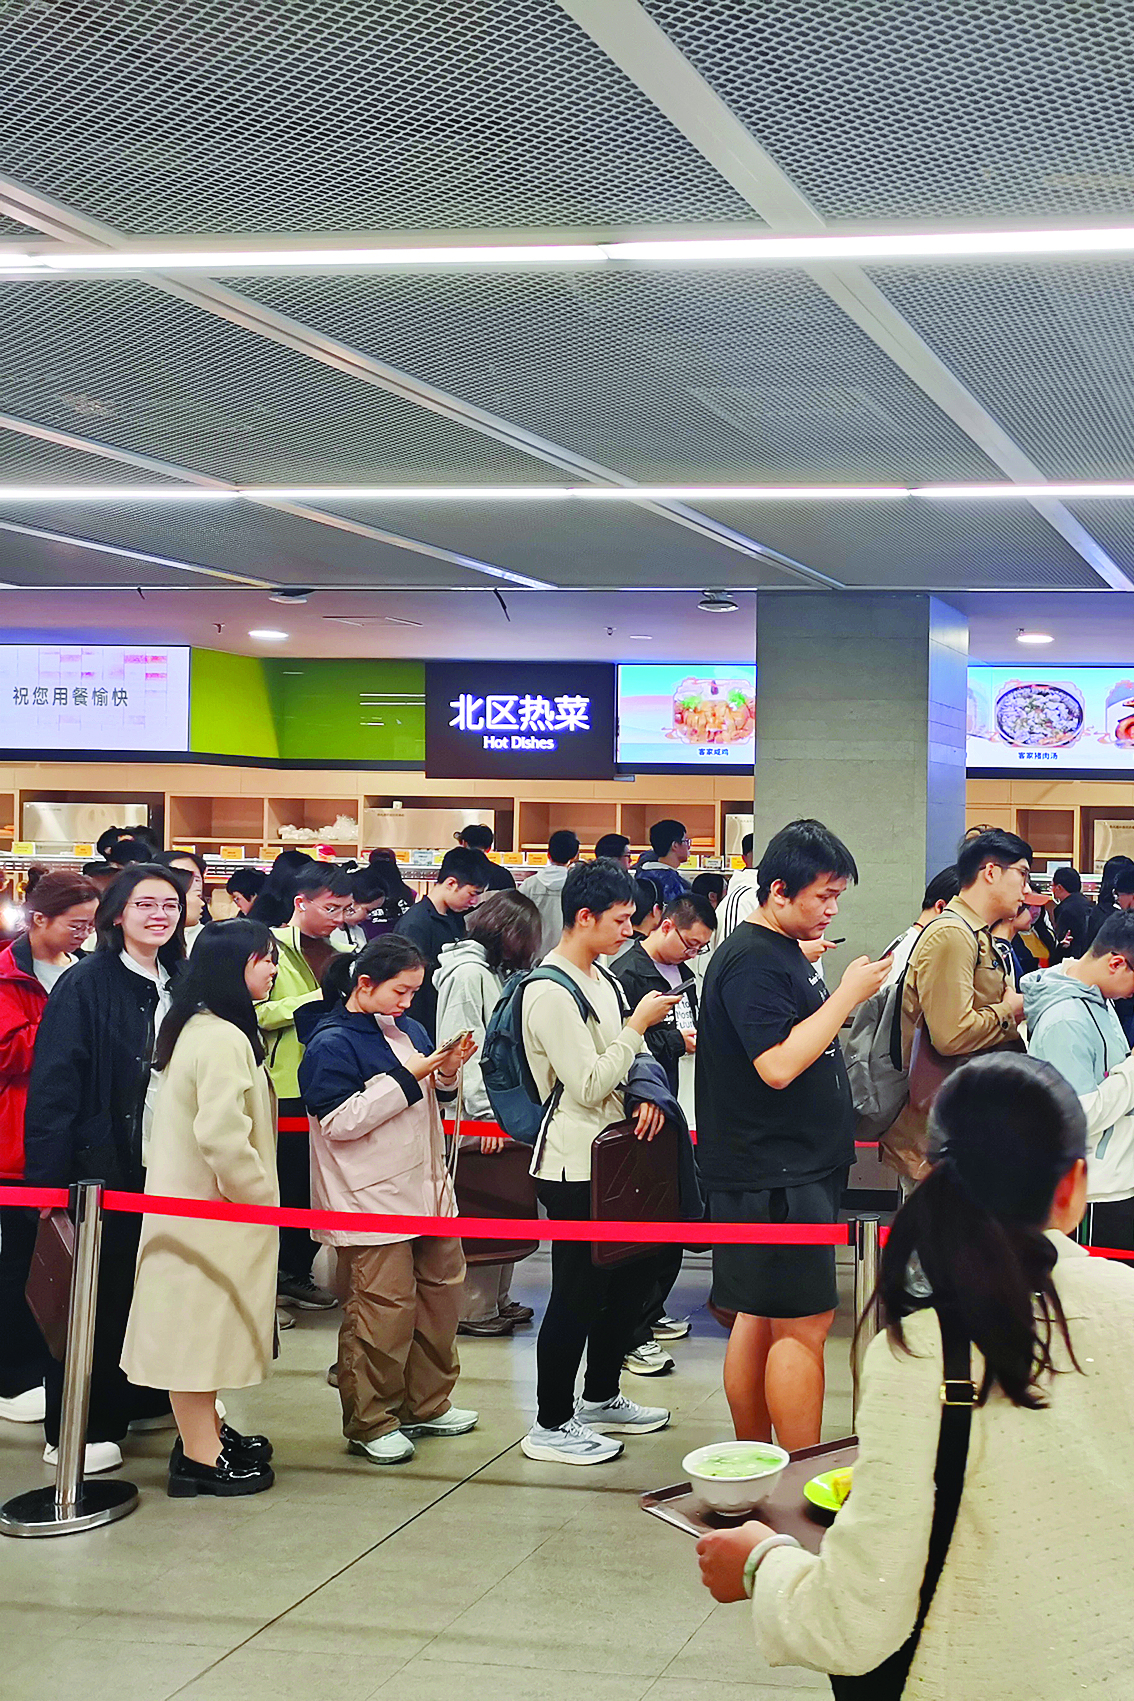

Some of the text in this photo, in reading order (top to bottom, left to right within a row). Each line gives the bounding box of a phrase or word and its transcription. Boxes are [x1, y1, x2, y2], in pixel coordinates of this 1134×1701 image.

[12, 686, 129, 707] 祝您用餐愉快
[449, 693, 591, 731] 北区热菜
[483, 735, 555, 750] Hot Dishes
[1018, 752, 1058, 760] 客家猪肉汤
